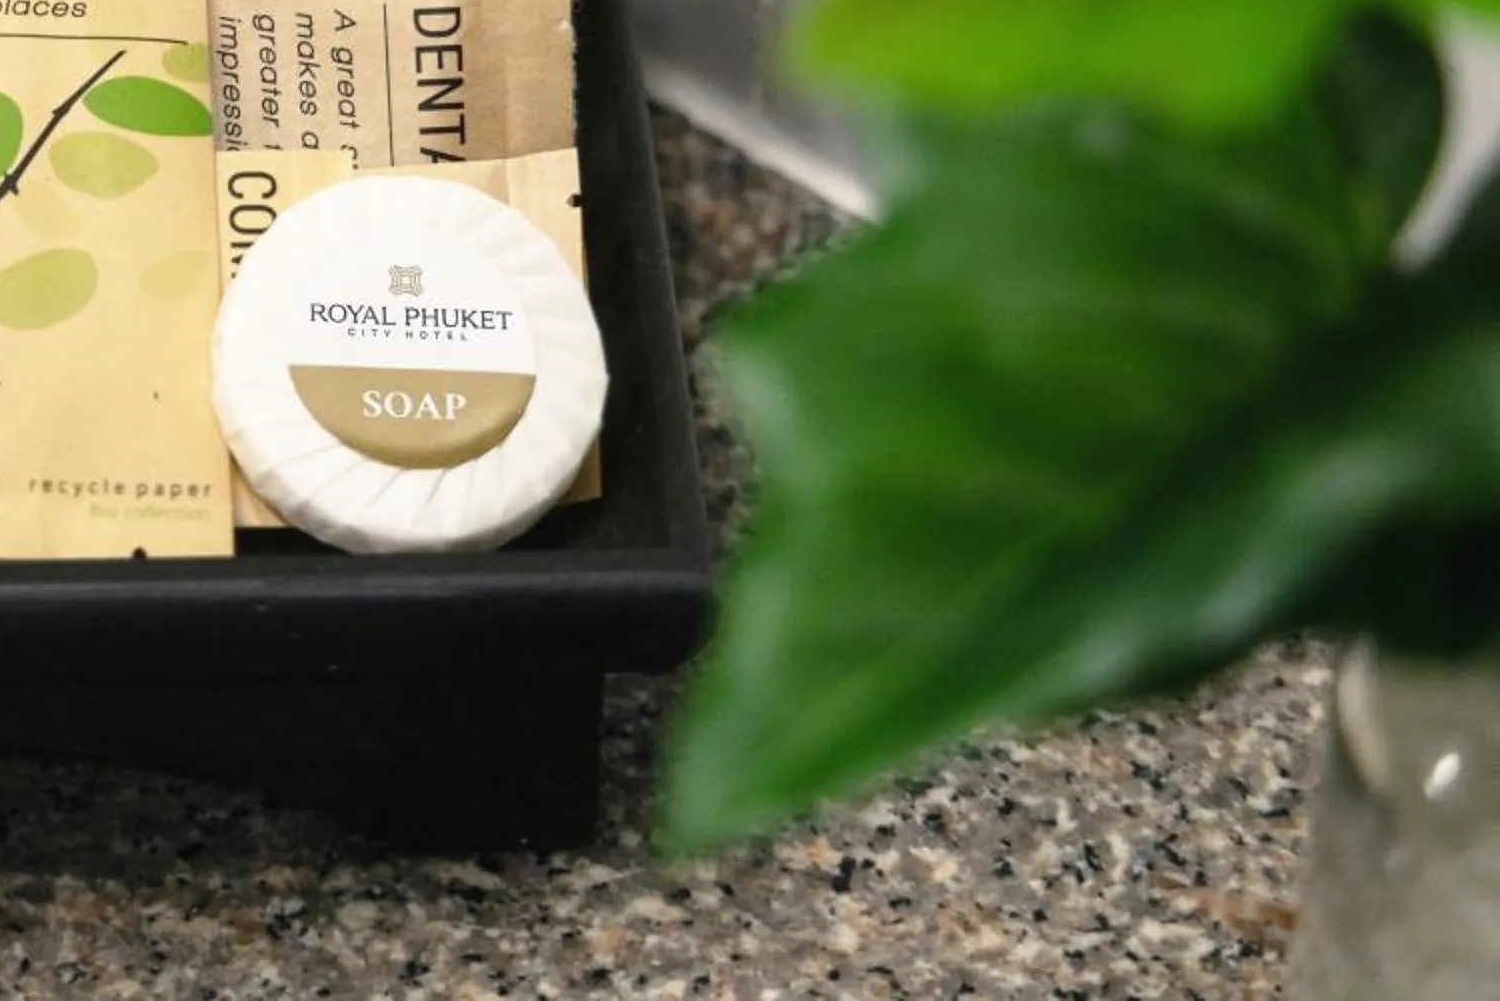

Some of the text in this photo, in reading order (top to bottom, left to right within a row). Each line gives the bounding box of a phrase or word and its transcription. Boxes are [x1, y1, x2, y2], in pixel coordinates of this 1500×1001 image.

[334, 10, 357, 31] A
[252, 13, 283, 128] greater
[294, 12, 319, 117] makes
[332, 46, 361, 130] great
[310, 303, 513, 331] ROYAL PHUKET
[347, 328, 468, 342] CITY HOTEL
[362, 390, 467, 420] SOAP
[29, 478, 211, 499] recycle paper
